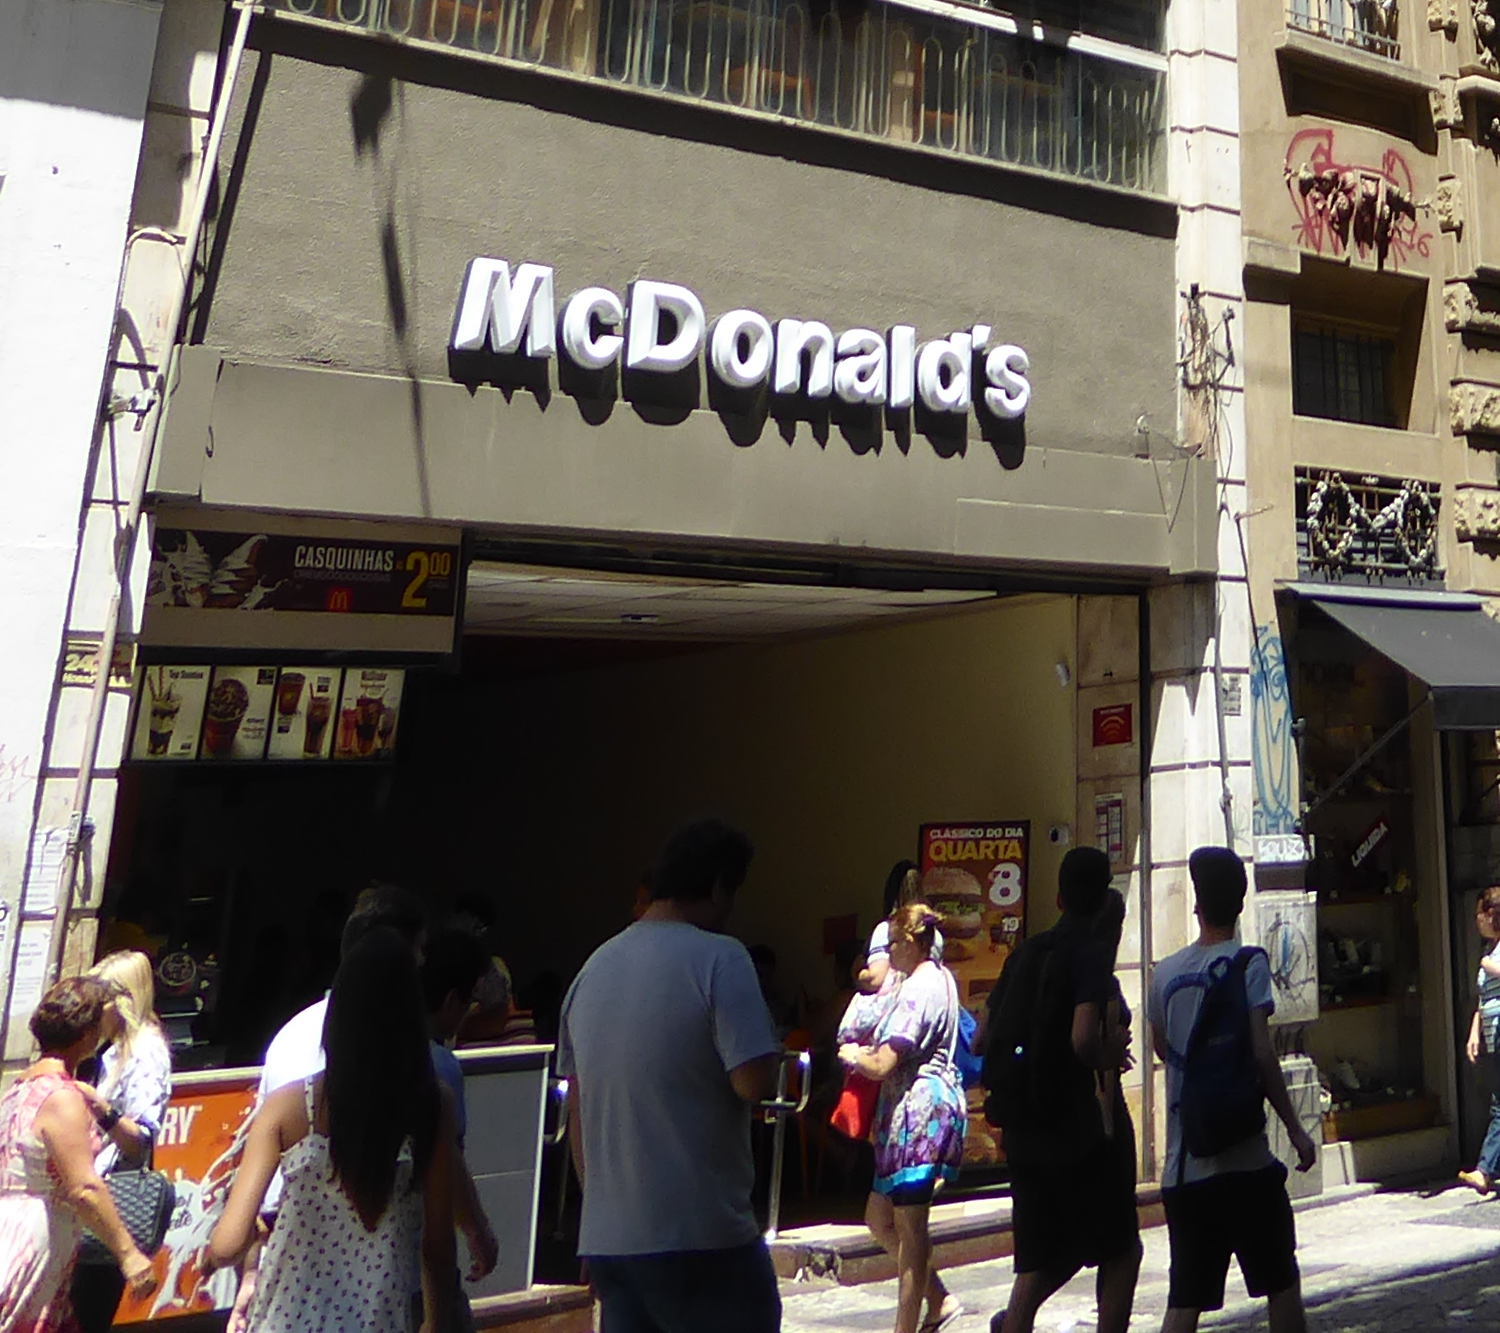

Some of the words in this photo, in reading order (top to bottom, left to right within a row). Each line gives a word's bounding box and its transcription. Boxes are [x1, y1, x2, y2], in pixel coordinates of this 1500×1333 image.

[449, 255, 1033, 420] McDonald's
[294, 544, 395, 572] CASQUINHAS
[928, 839, 1023, 861] QUARTA
[985, 828, 1003, 838] DO
[1004, 827, 1025, 838] DIA
[1350, 821, 1389, 867] LIQUIDA
[988, 862, 1022, 906] 8
